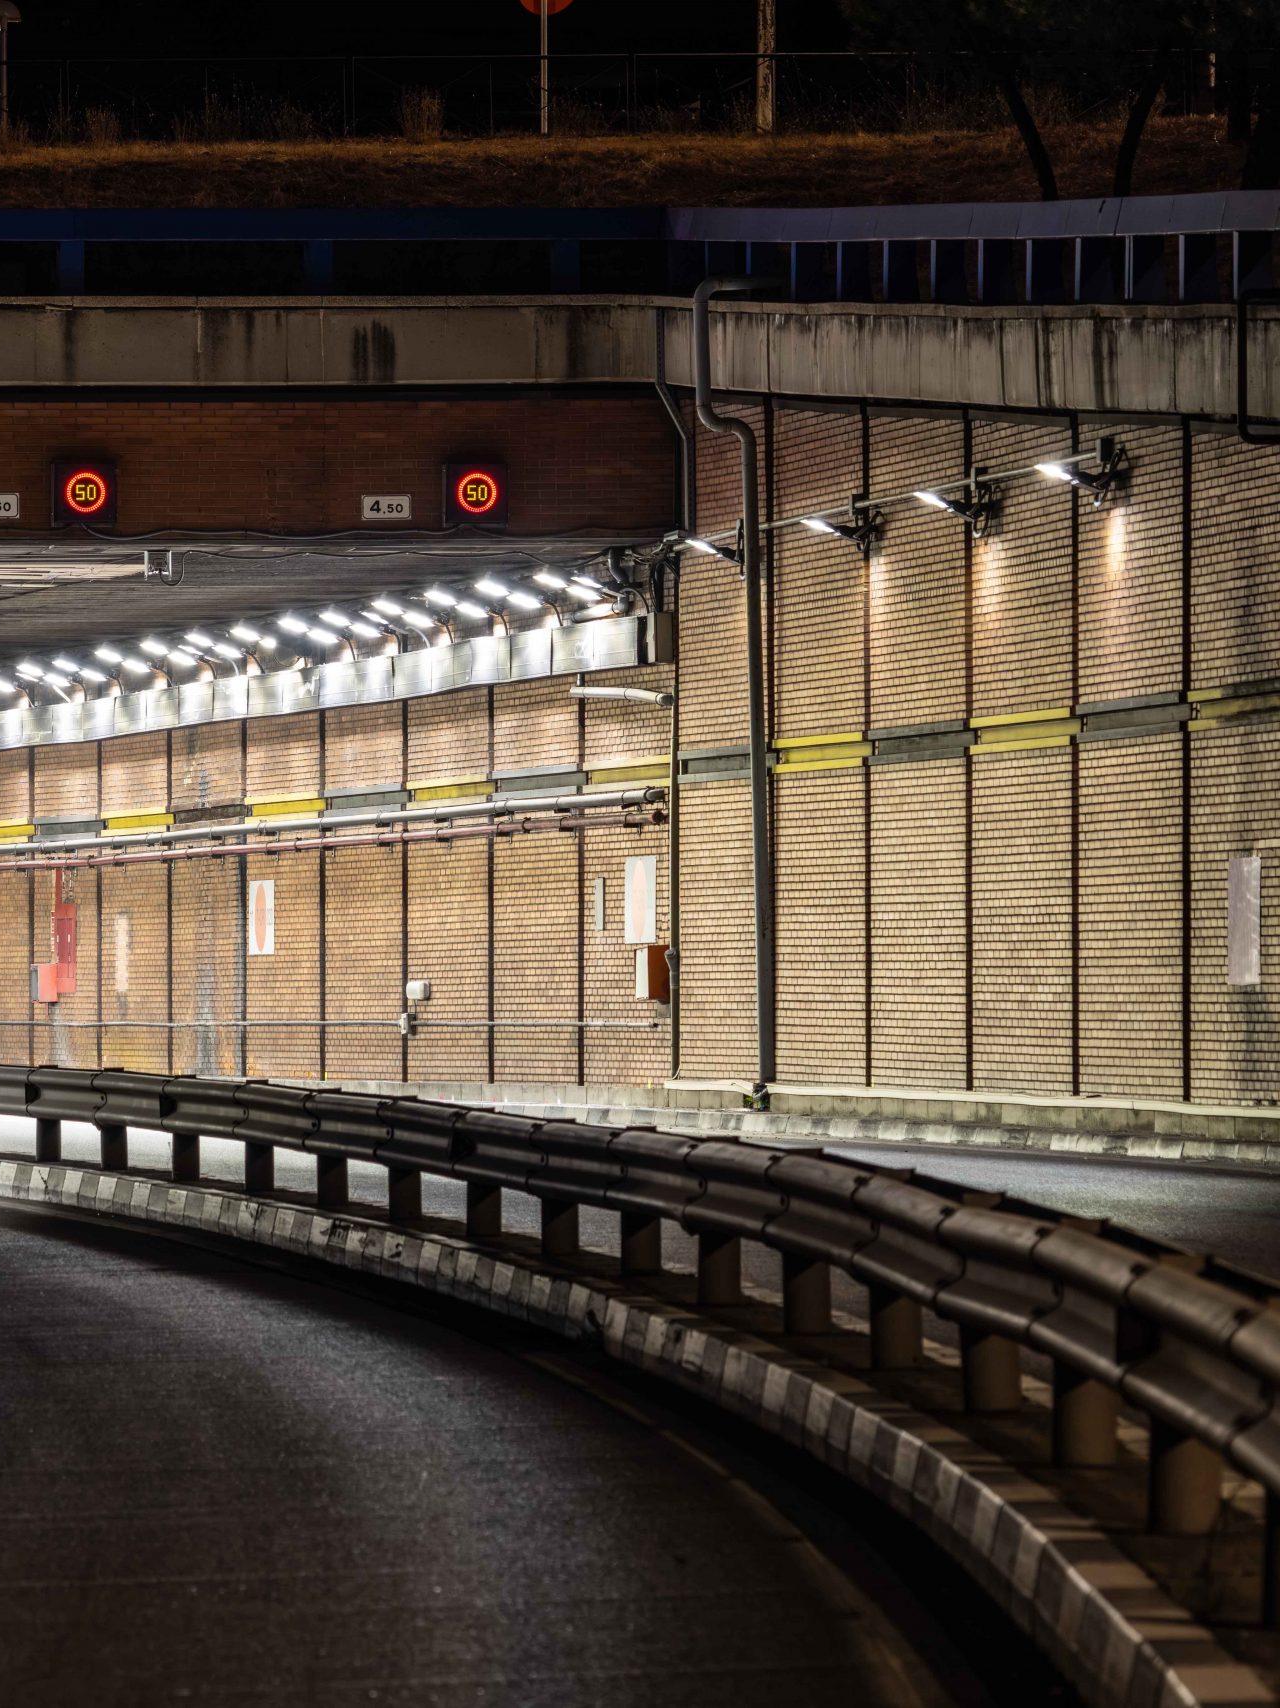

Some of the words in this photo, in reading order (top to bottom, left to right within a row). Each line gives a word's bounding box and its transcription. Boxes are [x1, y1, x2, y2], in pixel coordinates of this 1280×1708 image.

[75, 484, 97, 501] 50
[467, 485, 488, 501] 50
[370, 500, 404, 515] 4.50
